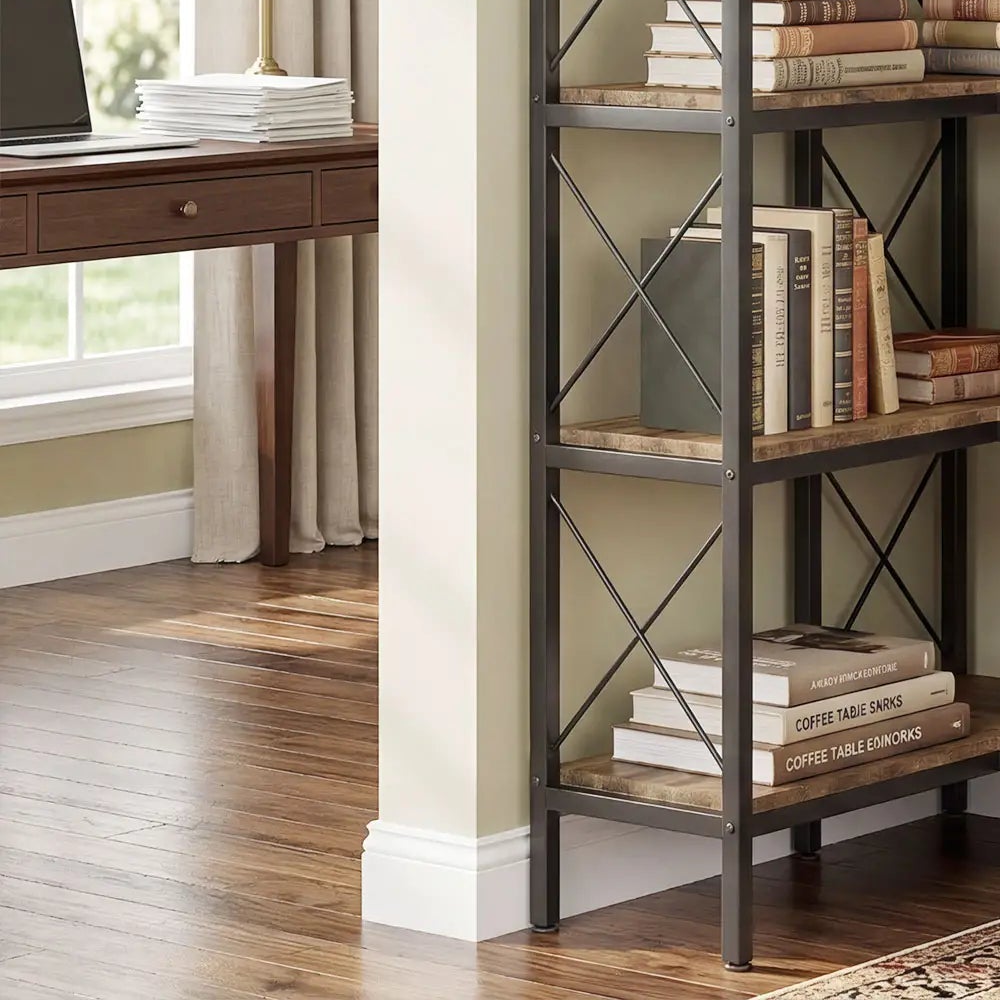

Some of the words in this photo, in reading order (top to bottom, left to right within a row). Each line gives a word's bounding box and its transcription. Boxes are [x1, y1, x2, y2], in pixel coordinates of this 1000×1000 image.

[795, 711, 834, 732] COFFEE
[785, 748, 828, 772] COFFEE
[830, 738, 865, 761] TABLE
